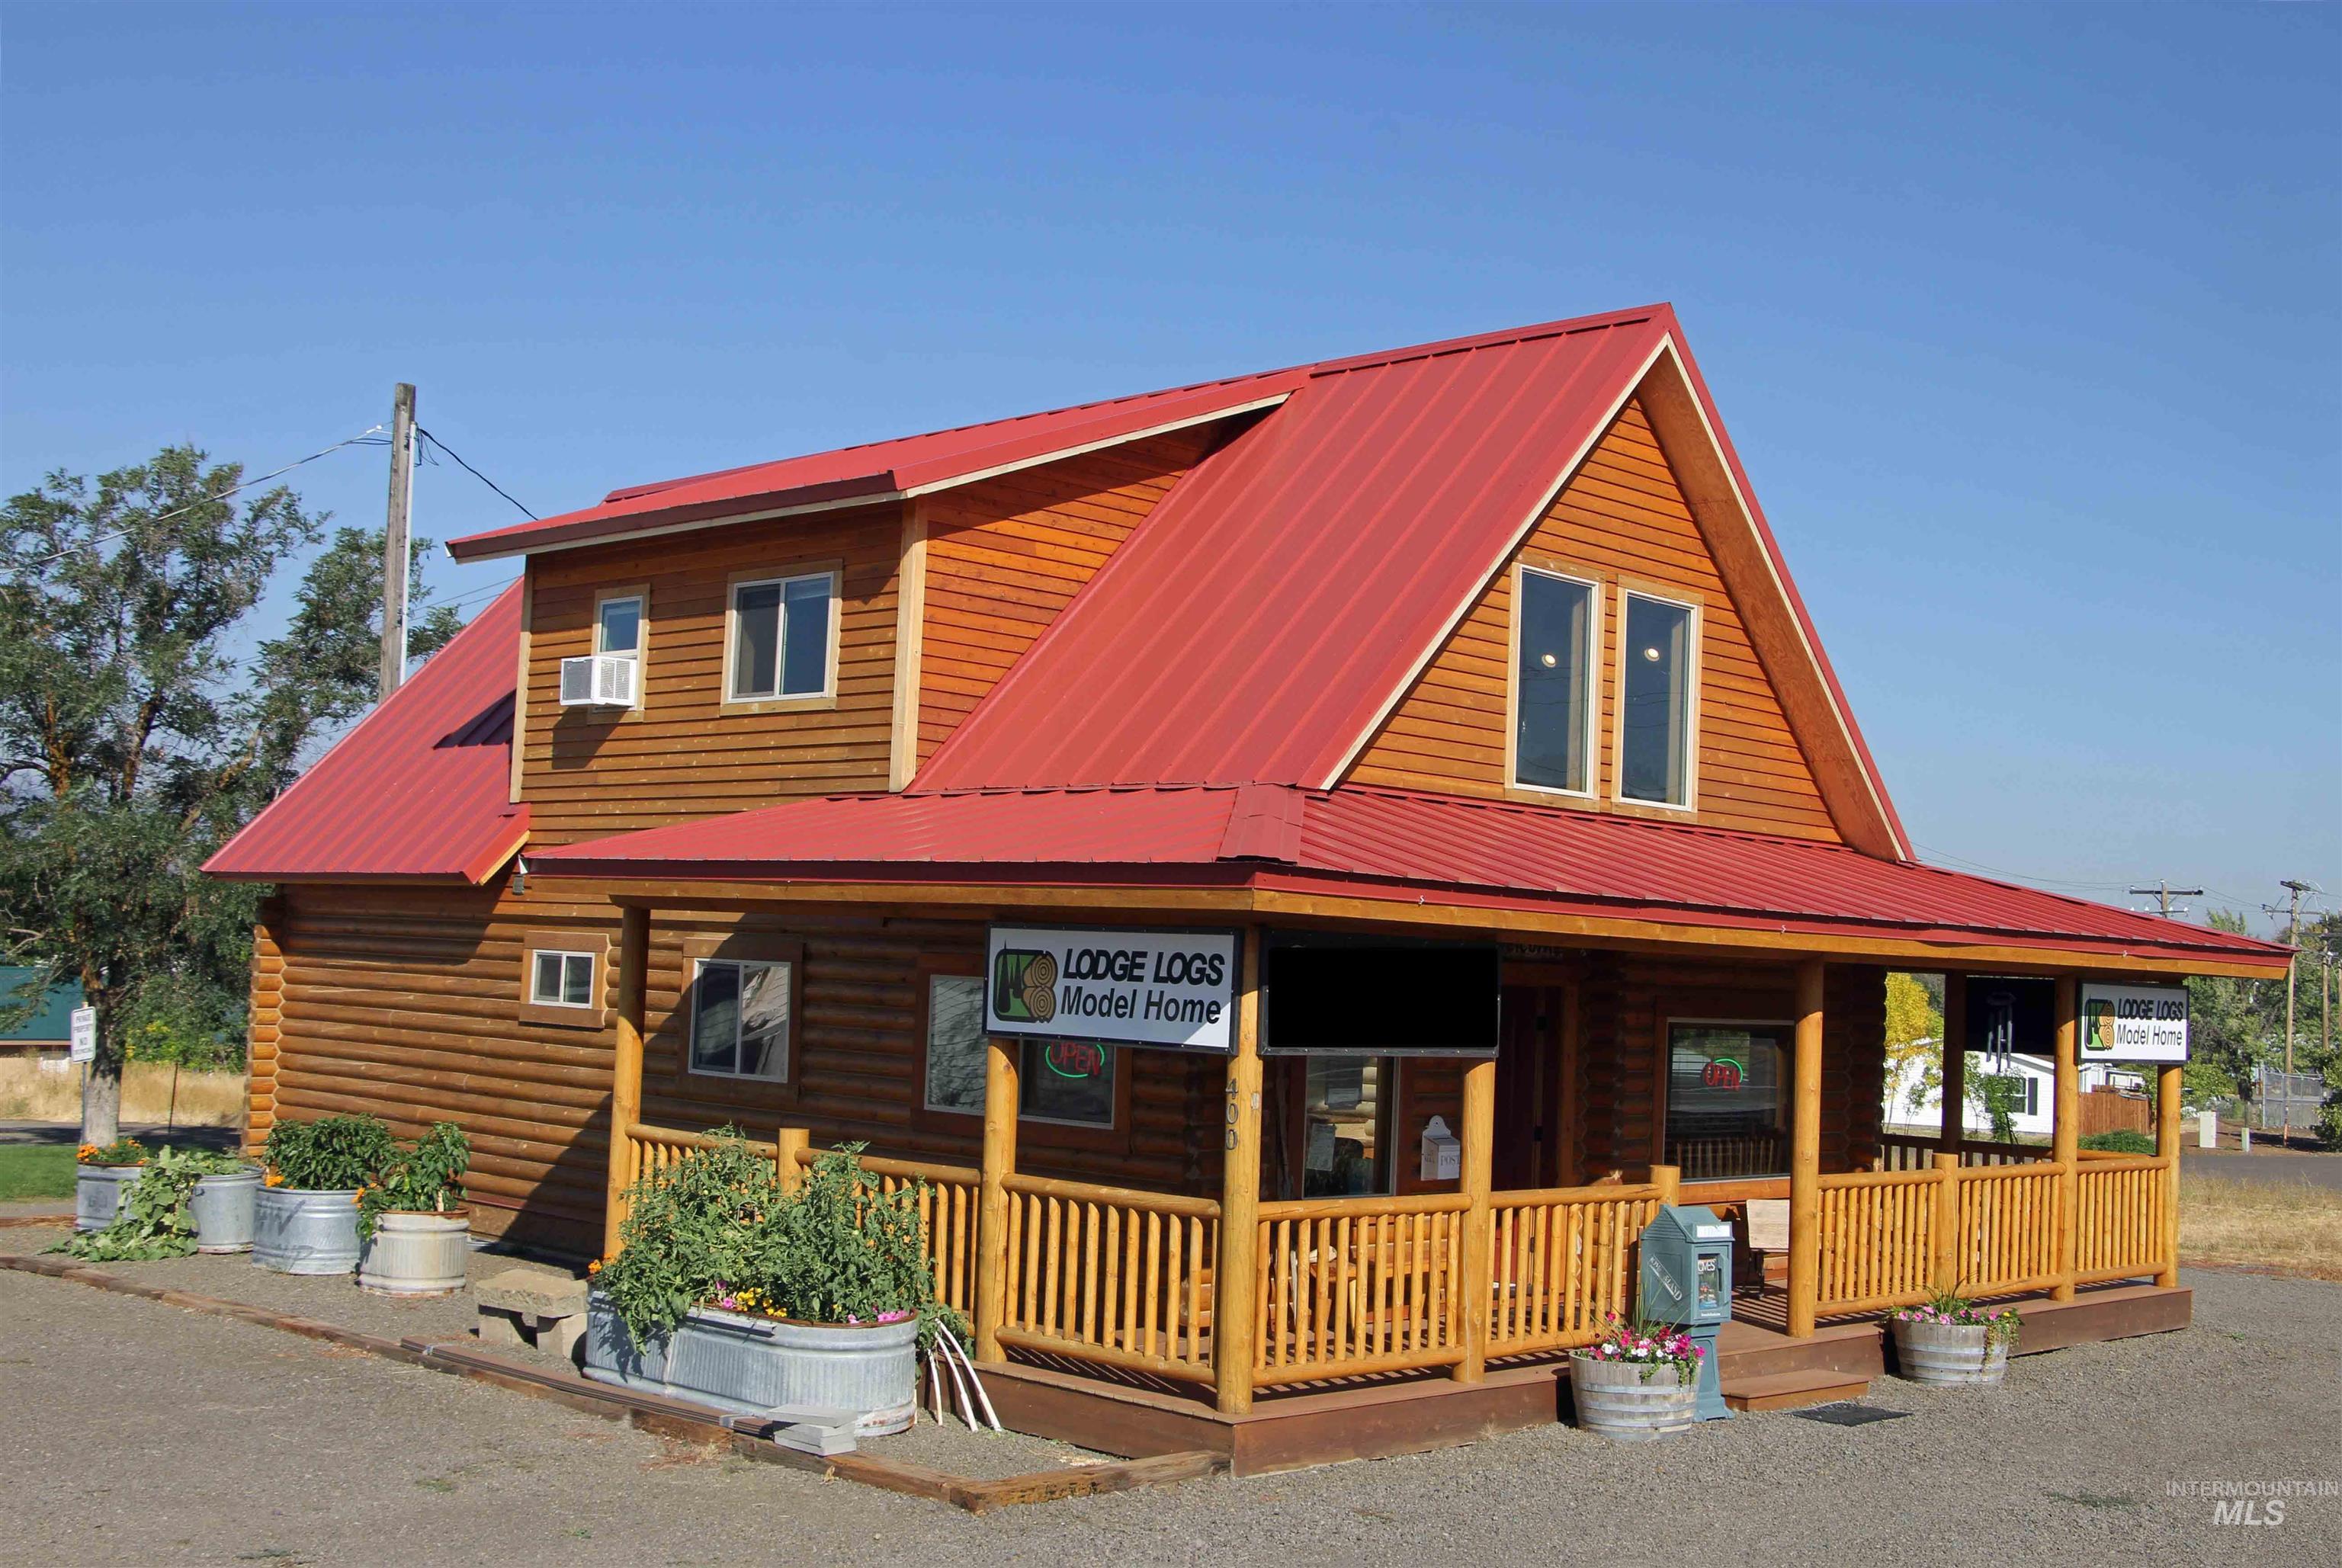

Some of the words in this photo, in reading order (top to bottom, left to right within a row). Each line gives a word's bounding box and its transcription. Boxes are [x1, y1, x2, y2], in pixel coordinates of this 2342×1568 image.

[1063, 948, 1148, 983] LODGE
[1153, 951, 1225, 986] LOGS
[1060, 986, 1137, 1018] Model
[1144, 989, 1221, 1024] Home
[2117, 999, 2154, 1020] LODGE
[2156, 999, 2184, 1021] LOGS
[2116, 1024, 2150, 1044] Model
[2153, 1025, 2183, 1046] Home
[1050, 1040, 1100, 1076] OPEN
[1704, 1061, 1741, 1091] OPEN
[1225, 1078, 1239, 1150] 400
[1440, 1154, 1459, 1166] POST
